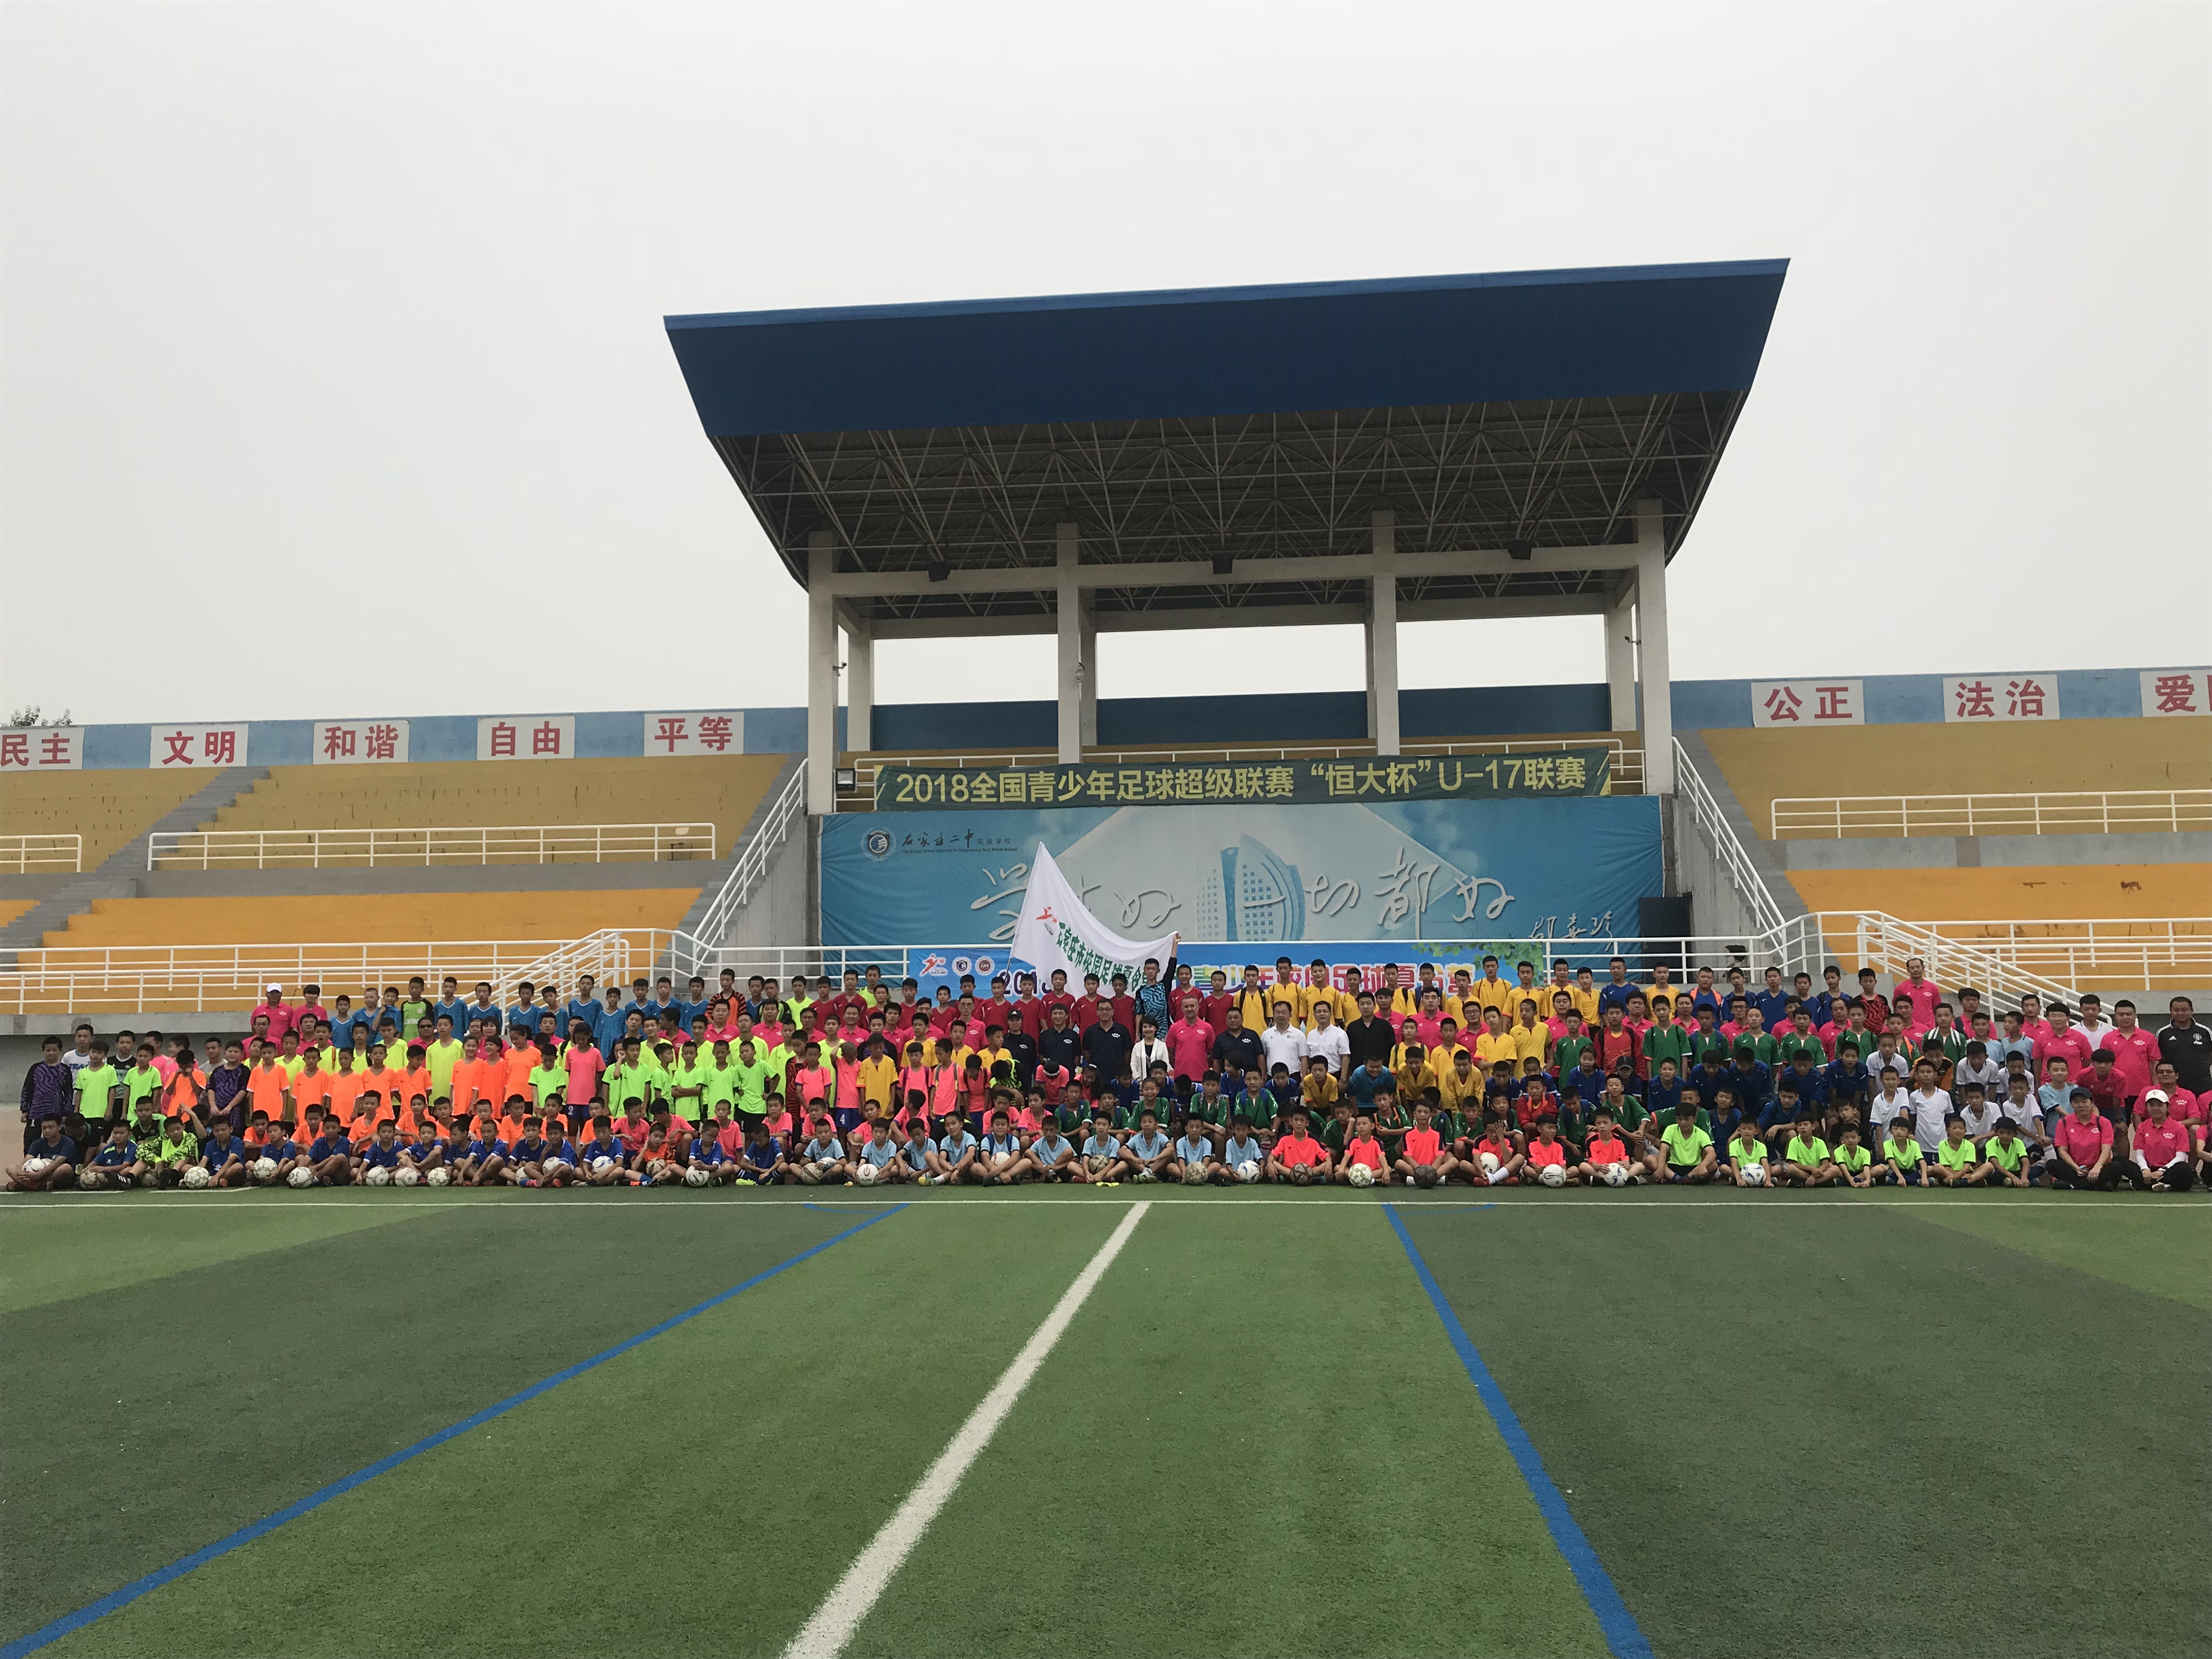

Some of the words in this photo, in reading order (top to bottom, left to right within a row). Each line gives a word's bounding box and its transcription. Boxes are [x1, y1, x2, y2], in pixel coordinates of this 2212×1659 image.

[1764, 686, 1853, 721] 公正
[1955, 679, 2045, 718] 法治
[2155, 674, 2212, 713] 爱
[0, 733, 71, 766] 民主
[162, 731, 236, 765] 文明
[324, 725, 399, 760] 和谐
[490, 721, 560, 756] 自由
[654, 716, 732, 752] 平等
